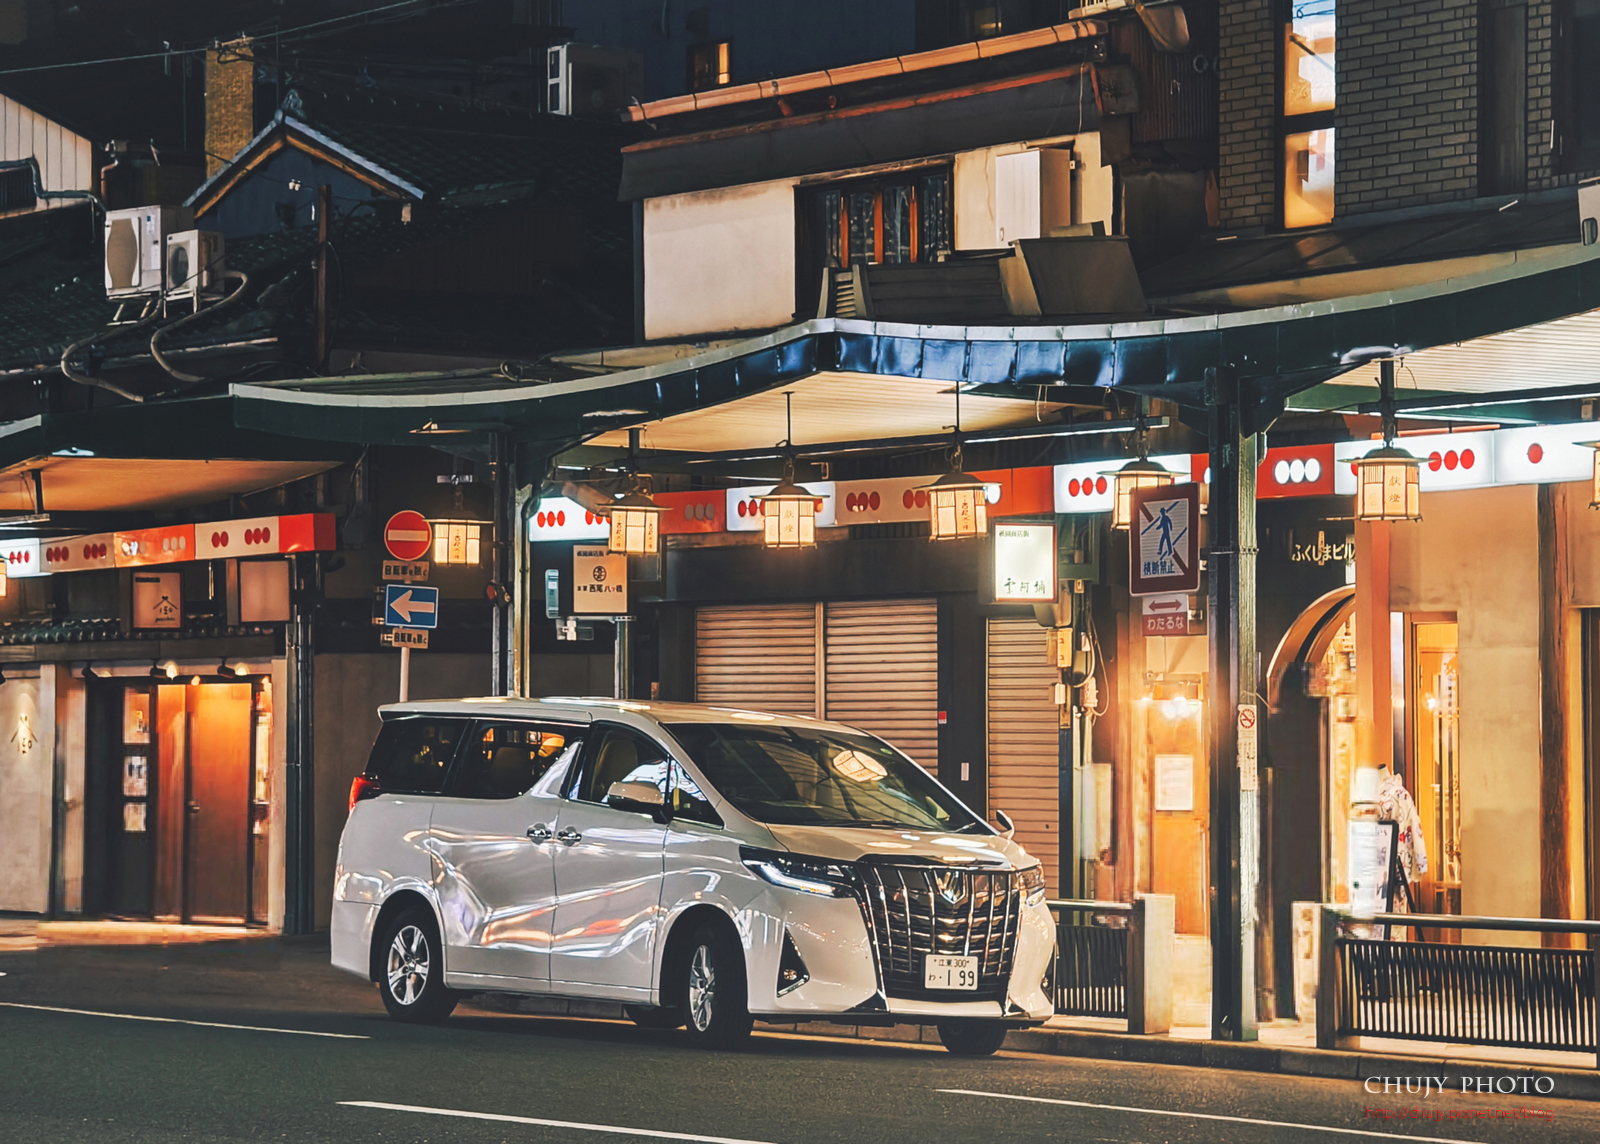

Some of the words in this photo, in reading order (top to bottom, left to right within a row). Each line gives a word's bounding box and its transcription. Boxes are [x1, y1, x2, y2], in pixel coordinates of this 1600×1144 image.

[1291, 543, 1356, 562] ふくしまビル
[1143, 560, 1175, 576] 横断禁止
[1146, 616, 1185, 631] わたるな
[953, 958, 967, 968] 300
